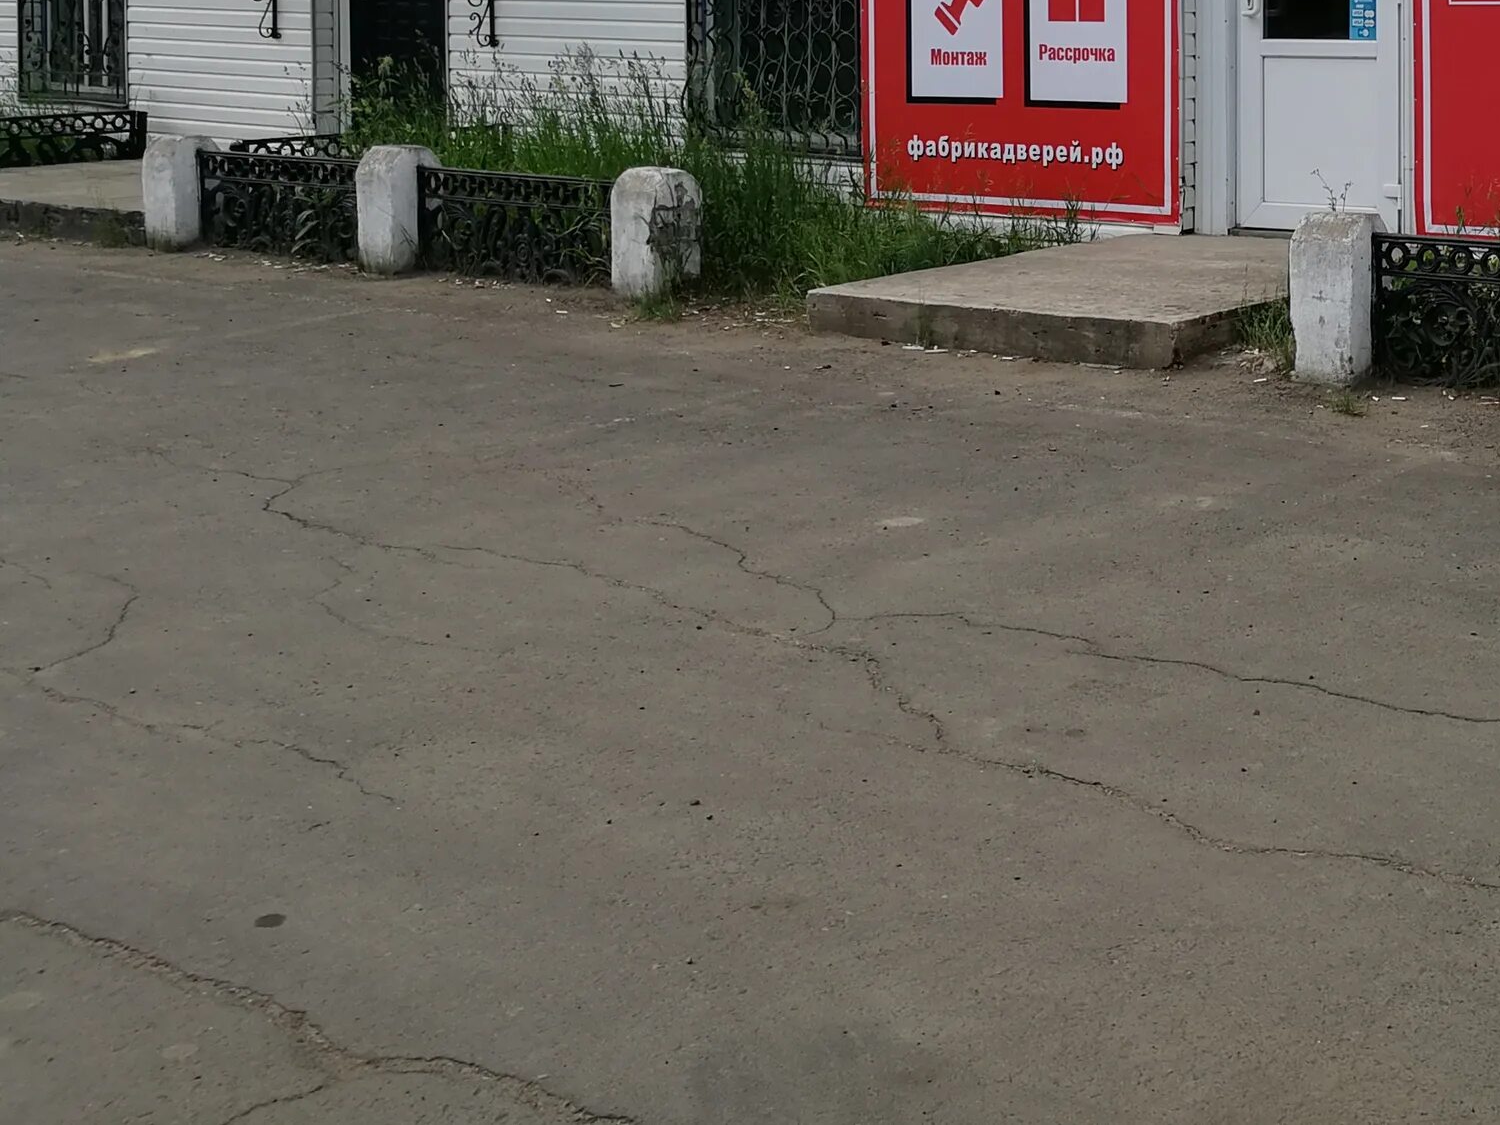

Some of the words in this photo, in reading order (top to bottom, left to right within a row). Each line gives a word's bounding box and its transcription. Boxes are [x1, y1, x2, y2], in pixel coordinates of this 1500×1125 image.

[930, 48, 988, 68] Монтаж
[1038, 43, 1115, 64] Рассрочка
[907, 134, 1124, 169] фабрикадверей.рф
